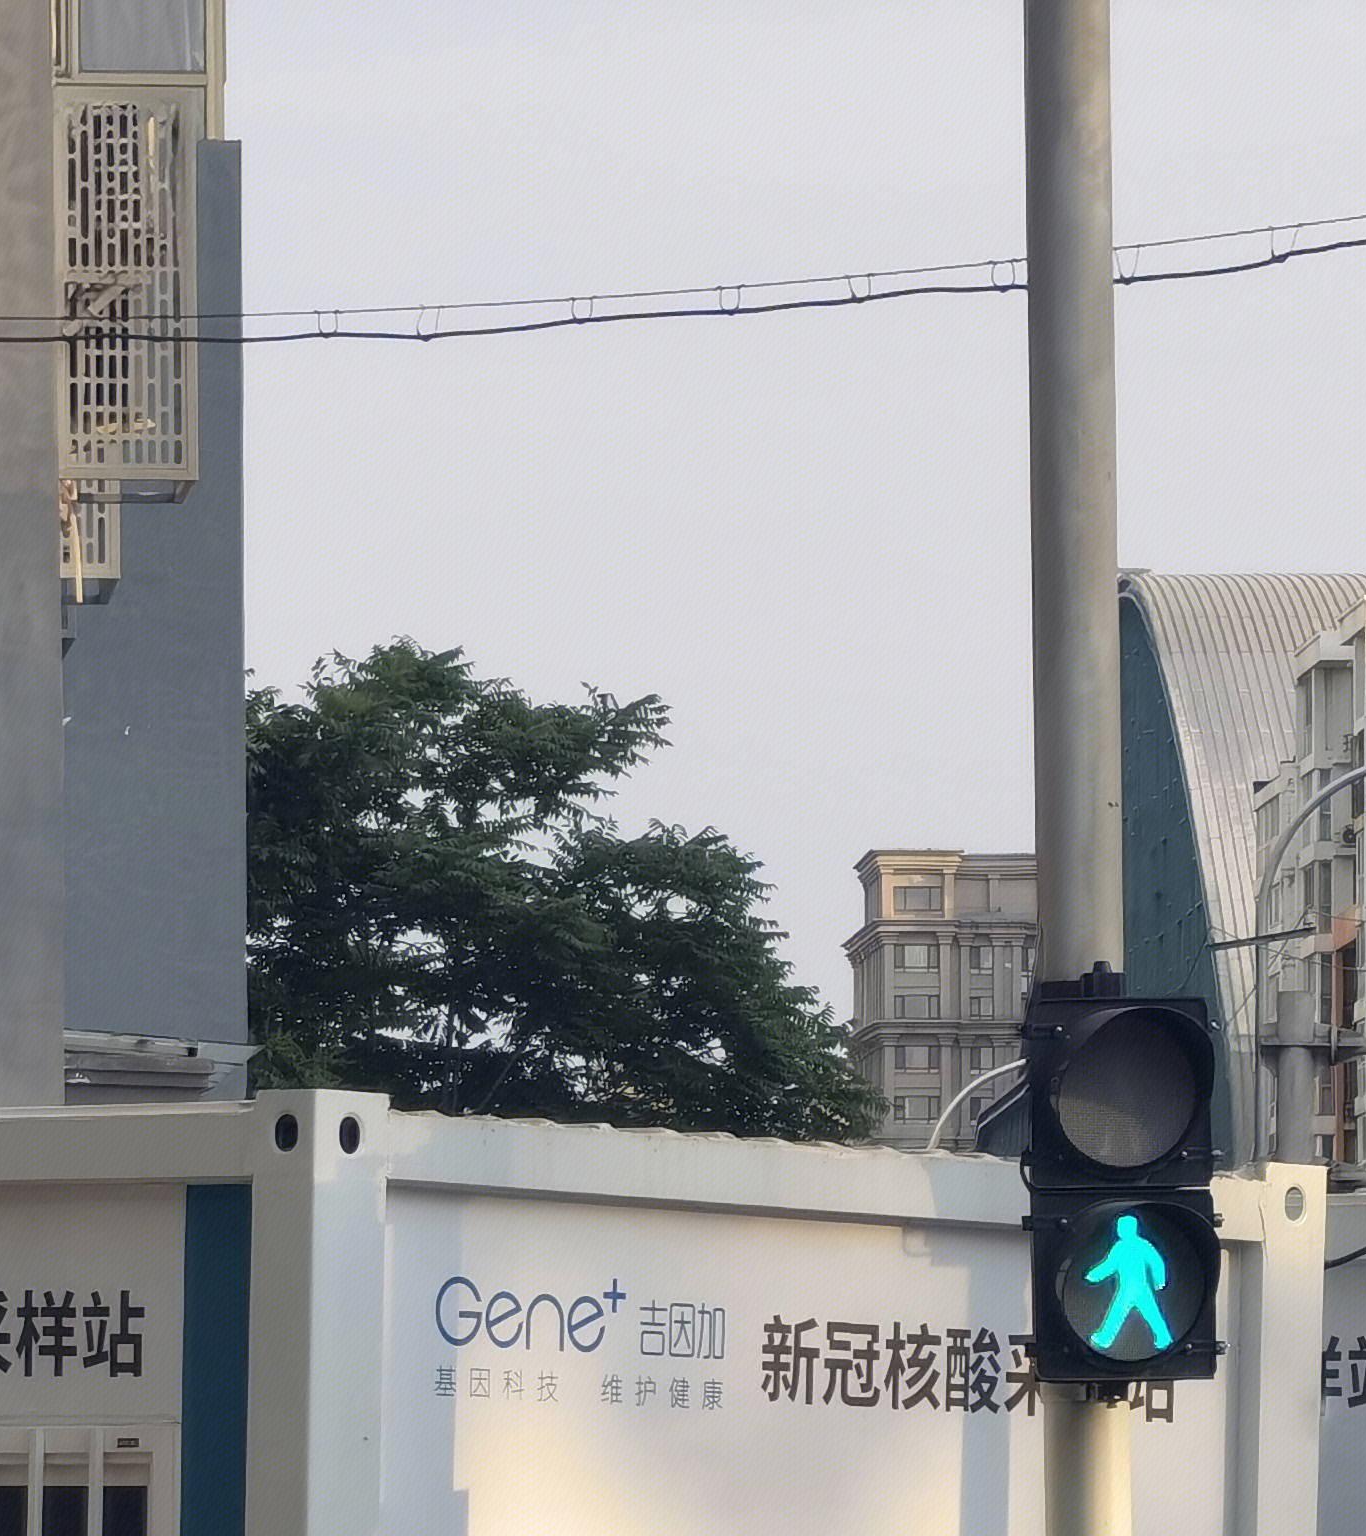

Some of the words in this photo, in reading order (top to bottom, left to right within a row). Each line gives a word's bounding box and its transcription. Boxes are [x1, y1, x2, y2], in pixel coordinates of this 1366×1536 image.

[639, 1300, 725, 1359] 吉因加
[434, 1364, 559, 1403] 基因科技
[601, 1373, 724, 1411] 维护健康
[761, 1314, 1174, 1423] 新冠核酸采
